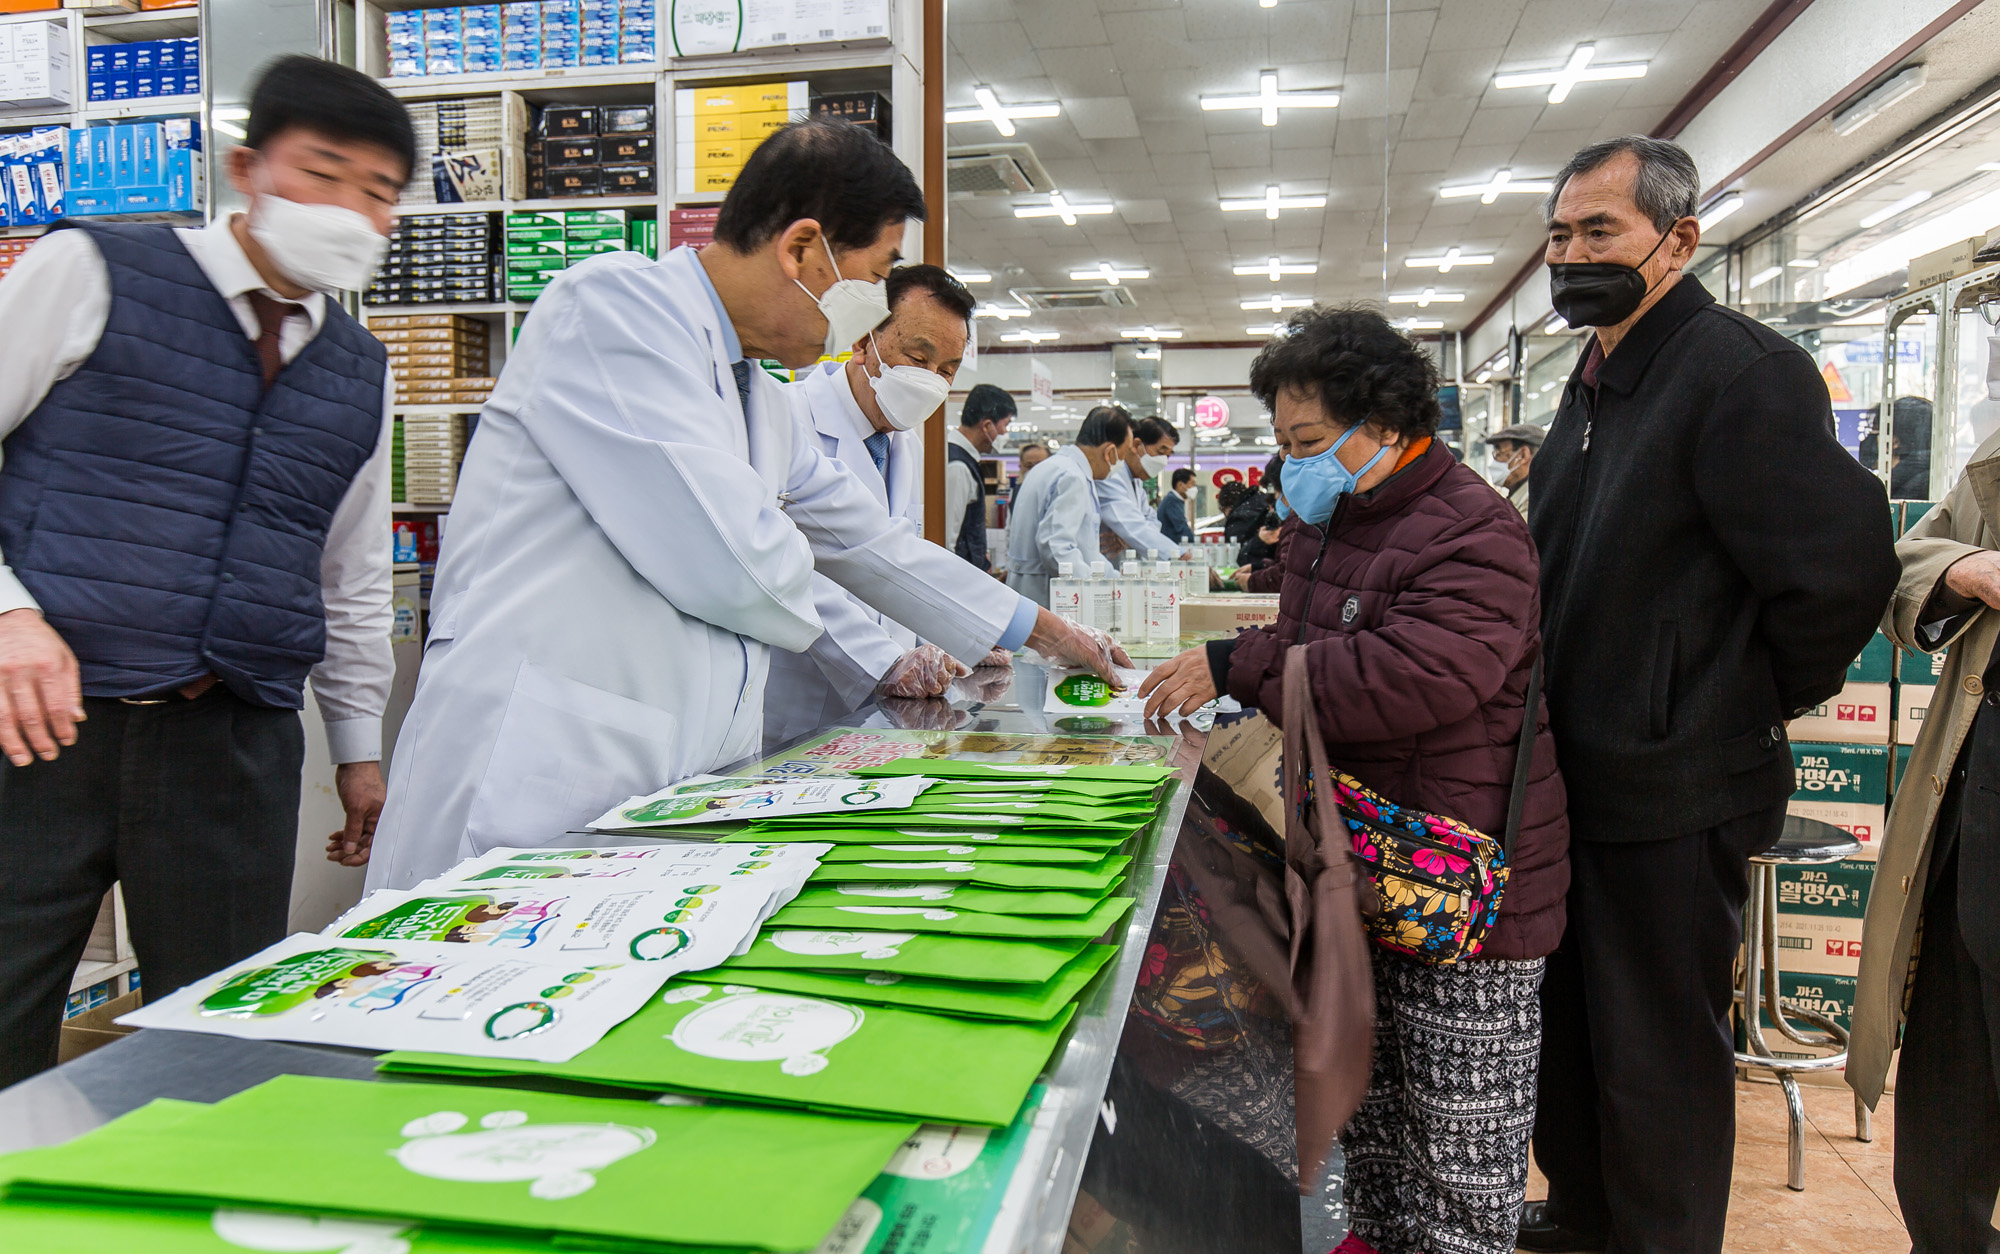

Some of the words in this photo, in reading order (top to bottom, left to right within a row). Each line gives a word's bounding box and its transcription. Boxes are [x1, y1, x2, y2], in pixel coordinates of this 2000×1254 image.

[1236, 613, 1266, 622] 피로회복
[1800, 756, 1830, 768] 까스
[1800, 870, 1828, 882] 까스
[239, 951, 350, 1002] 미세먼지
[279, 956, 358, 995] 마스크
[1795, 986, 1824, 998] 까스
